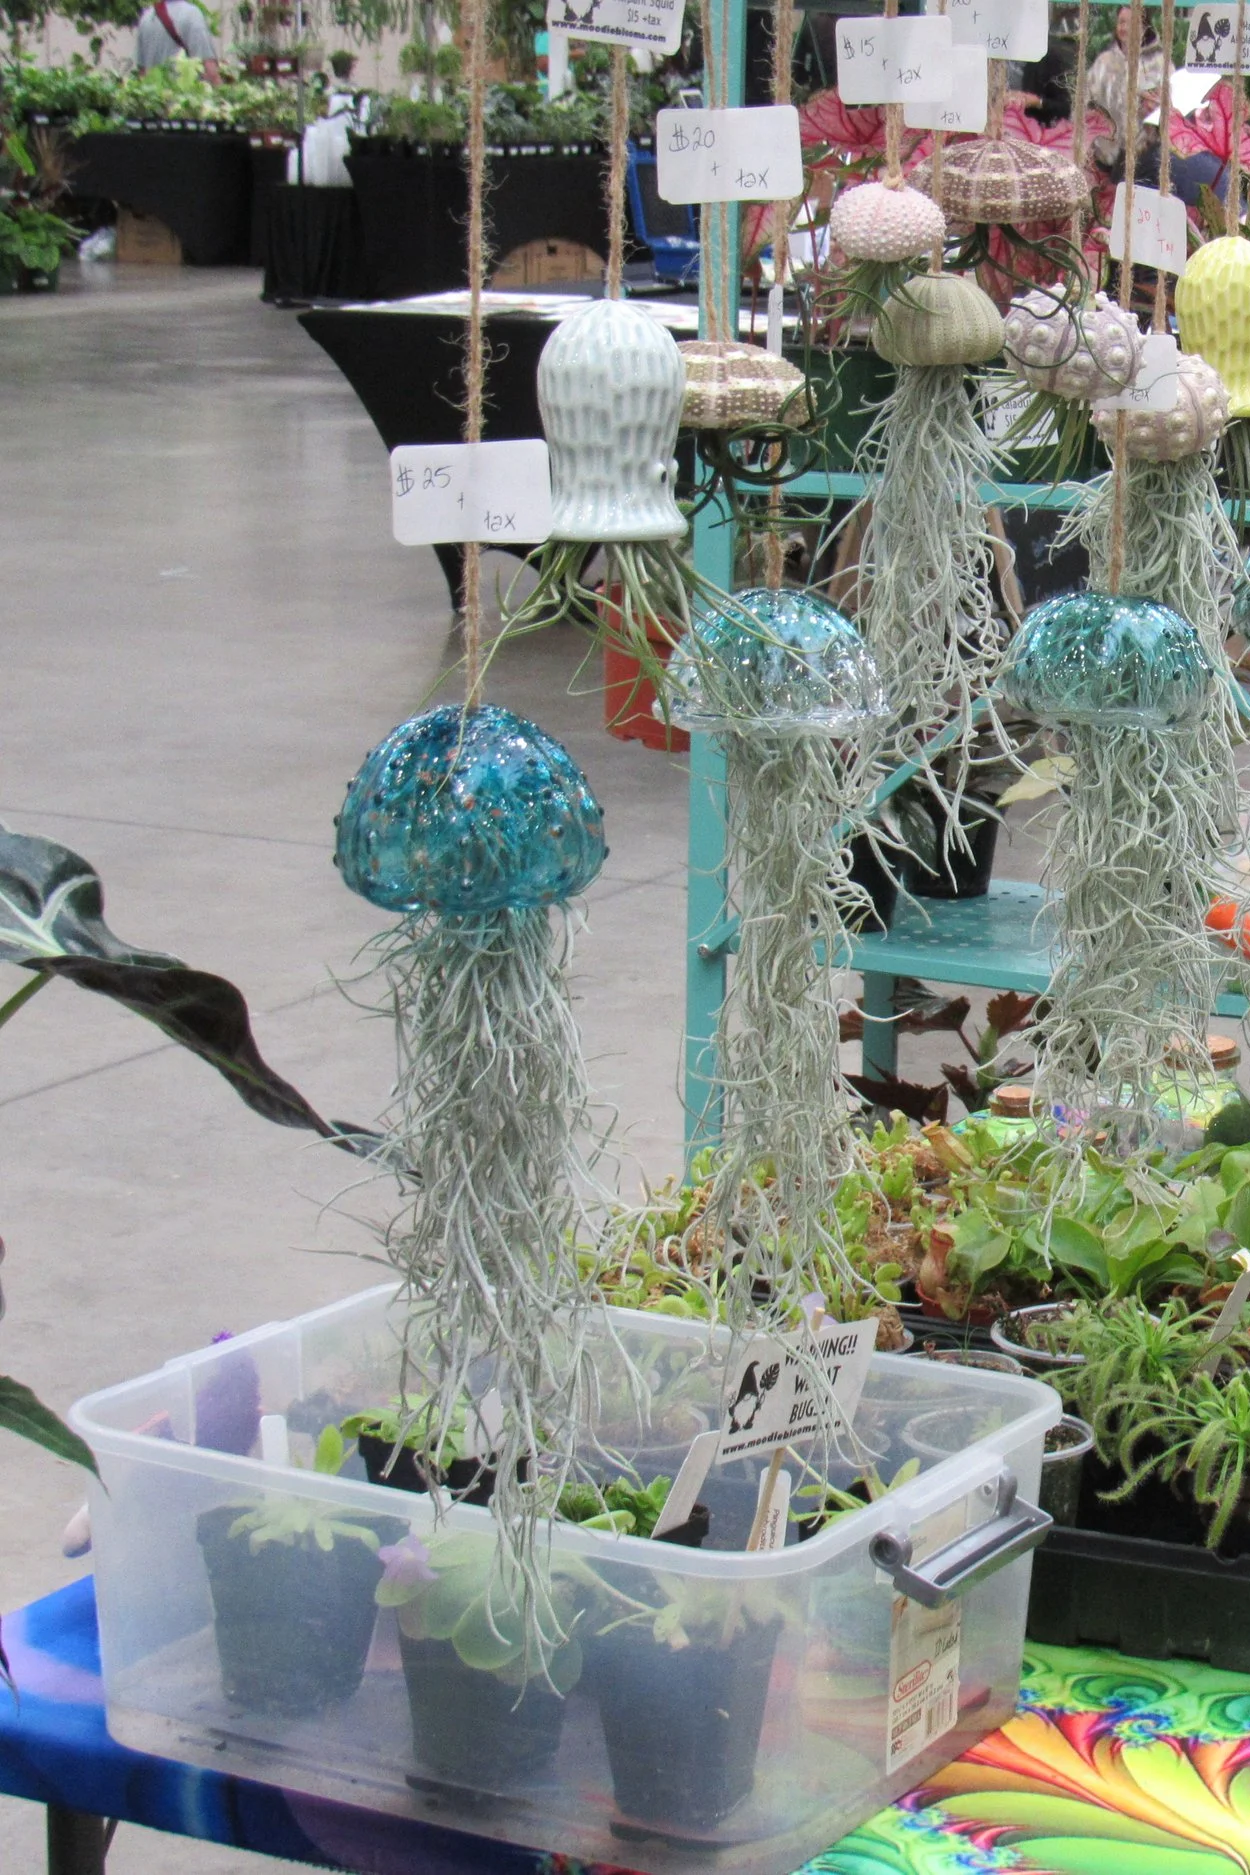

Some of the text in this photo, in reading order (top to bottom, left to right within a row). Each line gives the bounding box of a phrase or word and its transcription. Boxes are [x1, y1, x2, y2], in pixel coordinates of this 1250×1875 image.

[650, 0, 674, 10] Squid
[627, 8, 661, 25] $15 +tax
[844, 34, 875, 60] $15
[986, 33, 1008, 50] tax
[896, 64, 922, 85] tax
[940, 110, 961, 125] tax
[668, 123, 716, 153] $20
[735, 167, 770, 189] tax
[484, 509, 517, 532] tax
